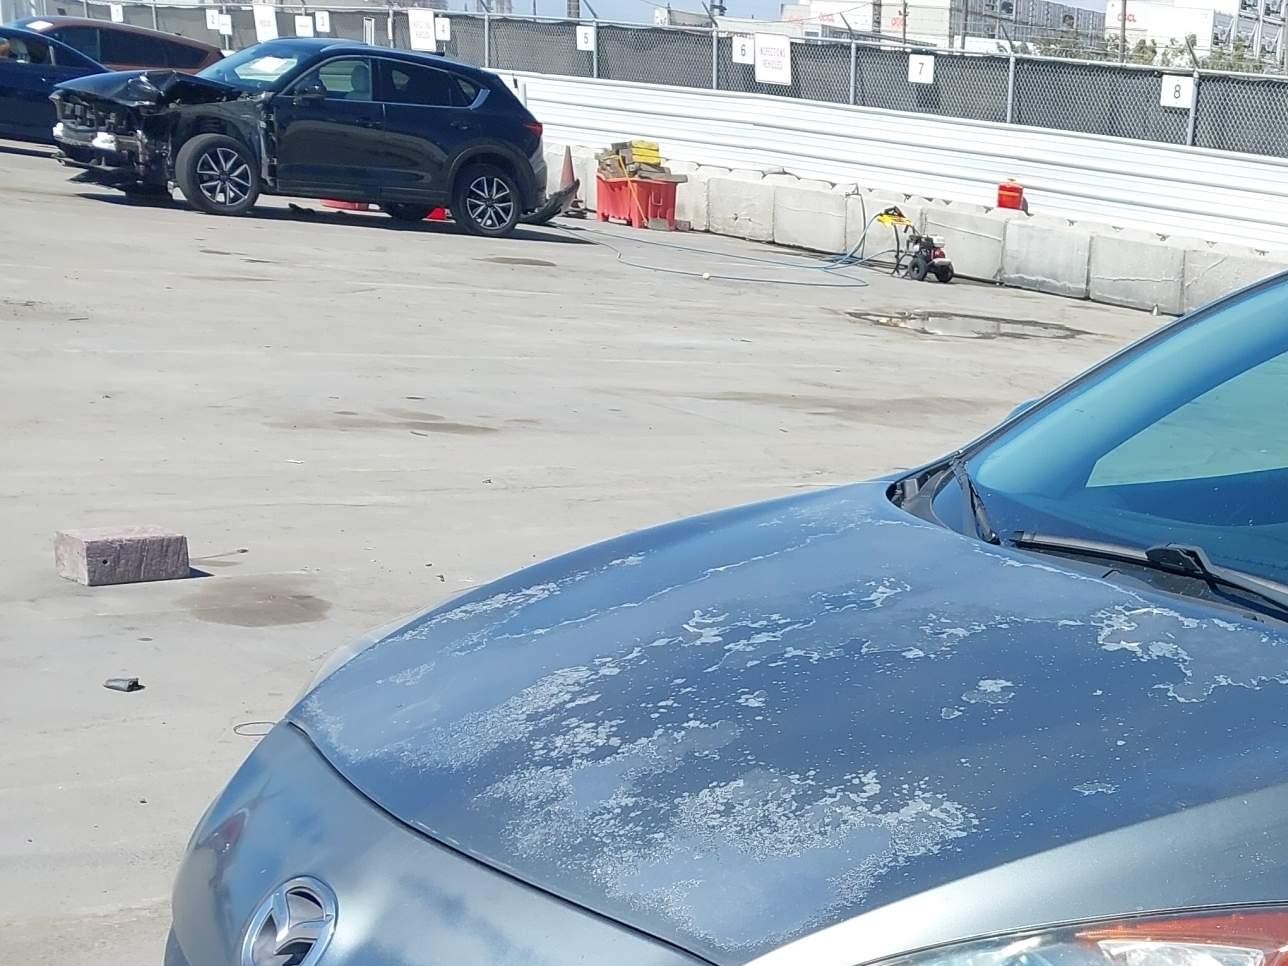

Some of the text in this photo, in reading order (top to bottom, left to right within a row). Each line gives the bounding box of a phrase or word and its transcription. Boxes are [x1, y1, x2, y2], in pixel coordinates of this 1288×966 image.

[583, 32, 589, 45] 5
[740, 43, 747, 57] 6
[918, 62, 925, 76] 7
[1173, 83, 1182, 99] 8
